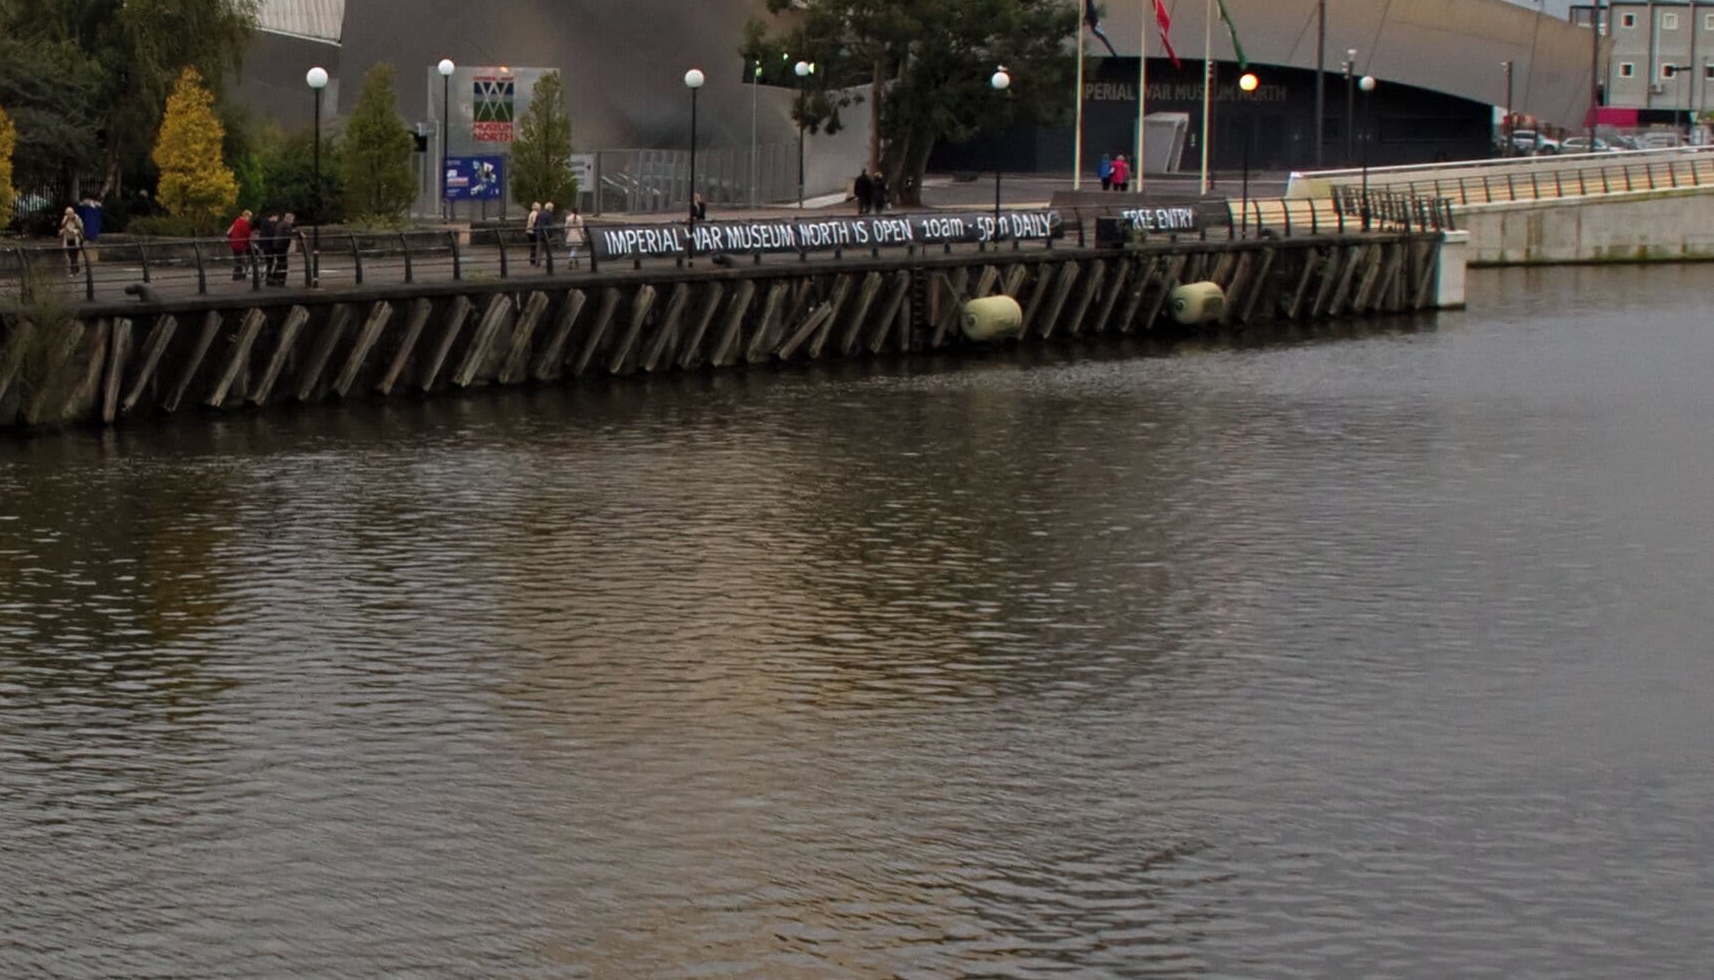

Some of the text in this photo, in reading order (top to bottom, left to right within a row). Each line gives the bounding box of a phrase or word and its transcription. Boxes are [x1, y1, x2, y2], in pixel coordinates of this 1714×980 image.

[472, 131, 513, 142] NORTH
[1156, 207, 1194, 229] ENTRY
[604, 227, 683, 255] IMPERIAL
[726, 223, 795, 249] MUSEUM
[799, 221, 850, 246] NORTH
[852, 221, 869, 243] IS
[873, 219, 913, 241] OPEN
[922, 218, 964, 238] 10am
[1011, 213, 1053, 237] DAILY
